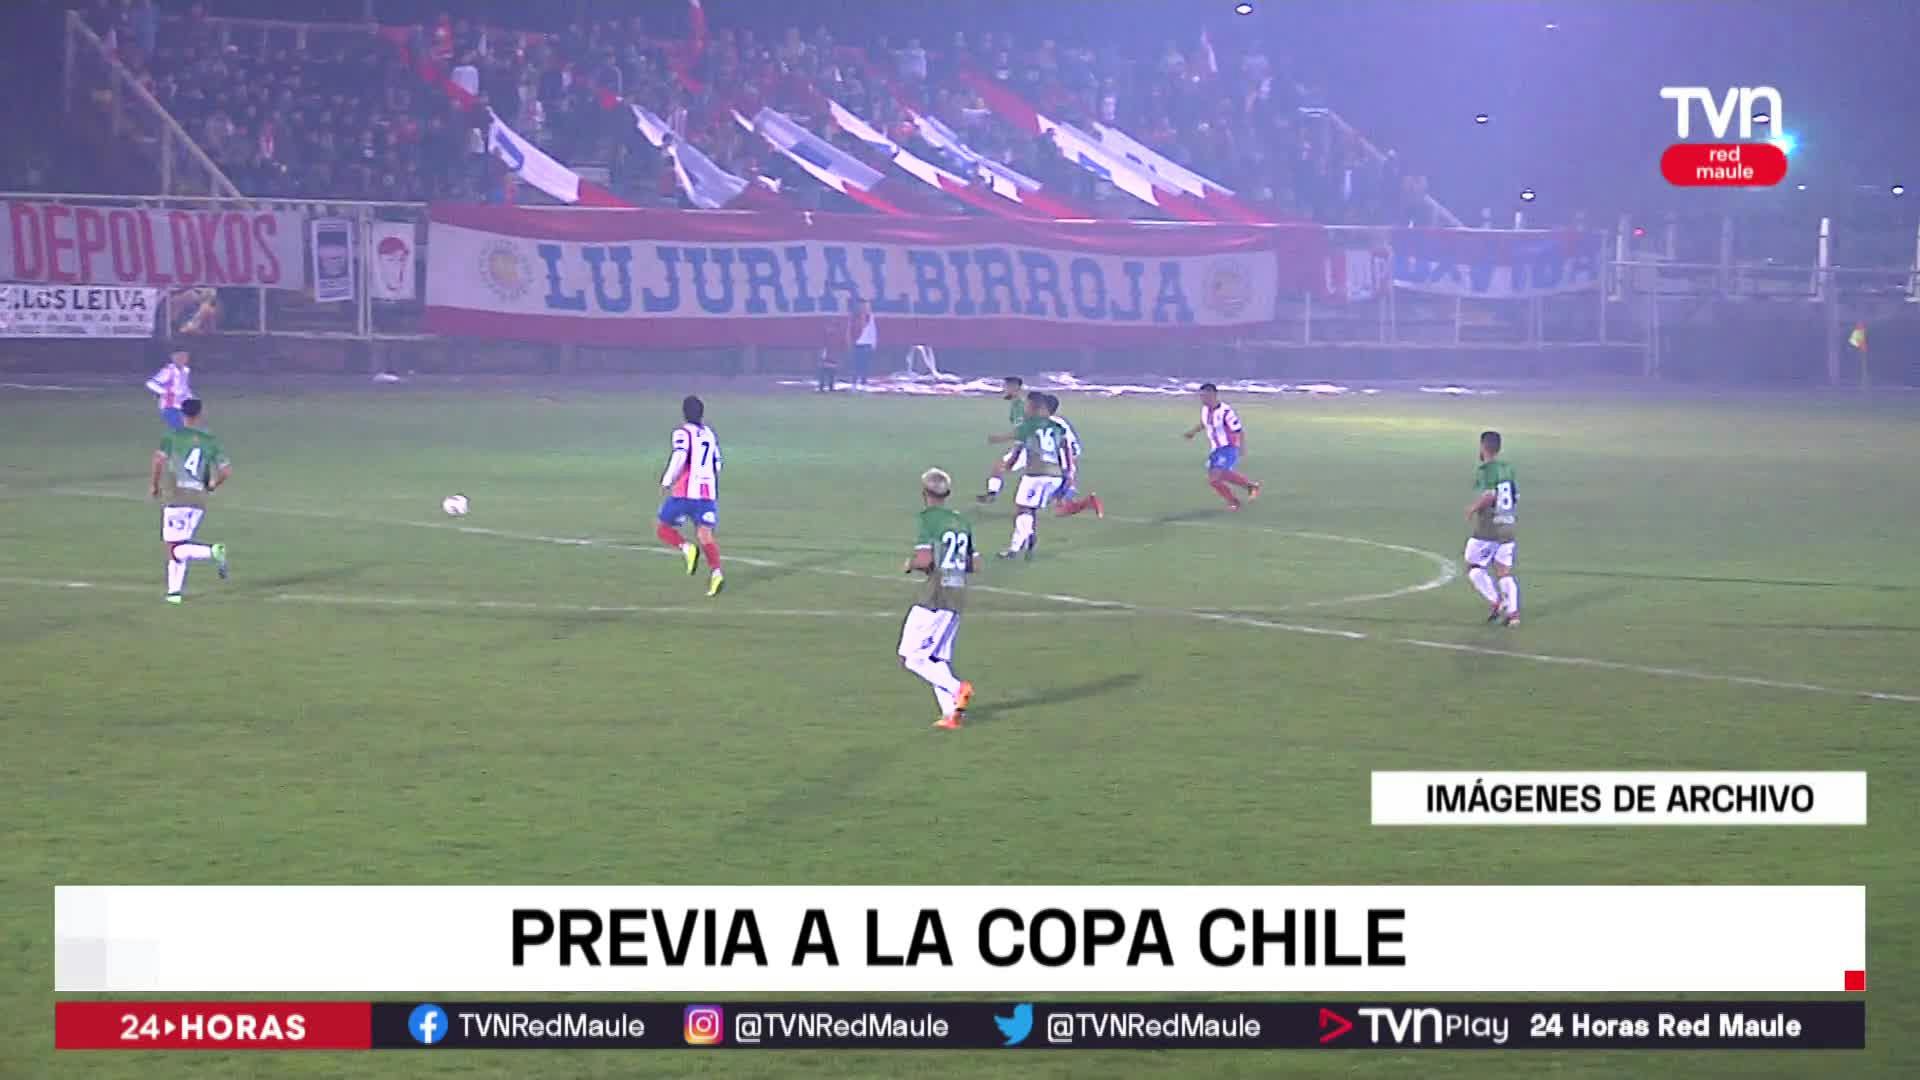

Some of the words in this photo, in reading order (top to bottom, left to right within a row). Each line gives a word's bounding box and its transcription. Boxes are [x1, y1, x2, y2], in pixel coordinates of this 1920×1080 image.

[10, 204, 281, 285] DEPOLOKOS
[73, 289, 146, 310] LEIVA
[538, 244, 1194, 322] LUJURIALBIRROJA
[184, 448, 201, 476] 4
[701, 441, 709, 466] 7
[941, 531, 968, 570] 23
